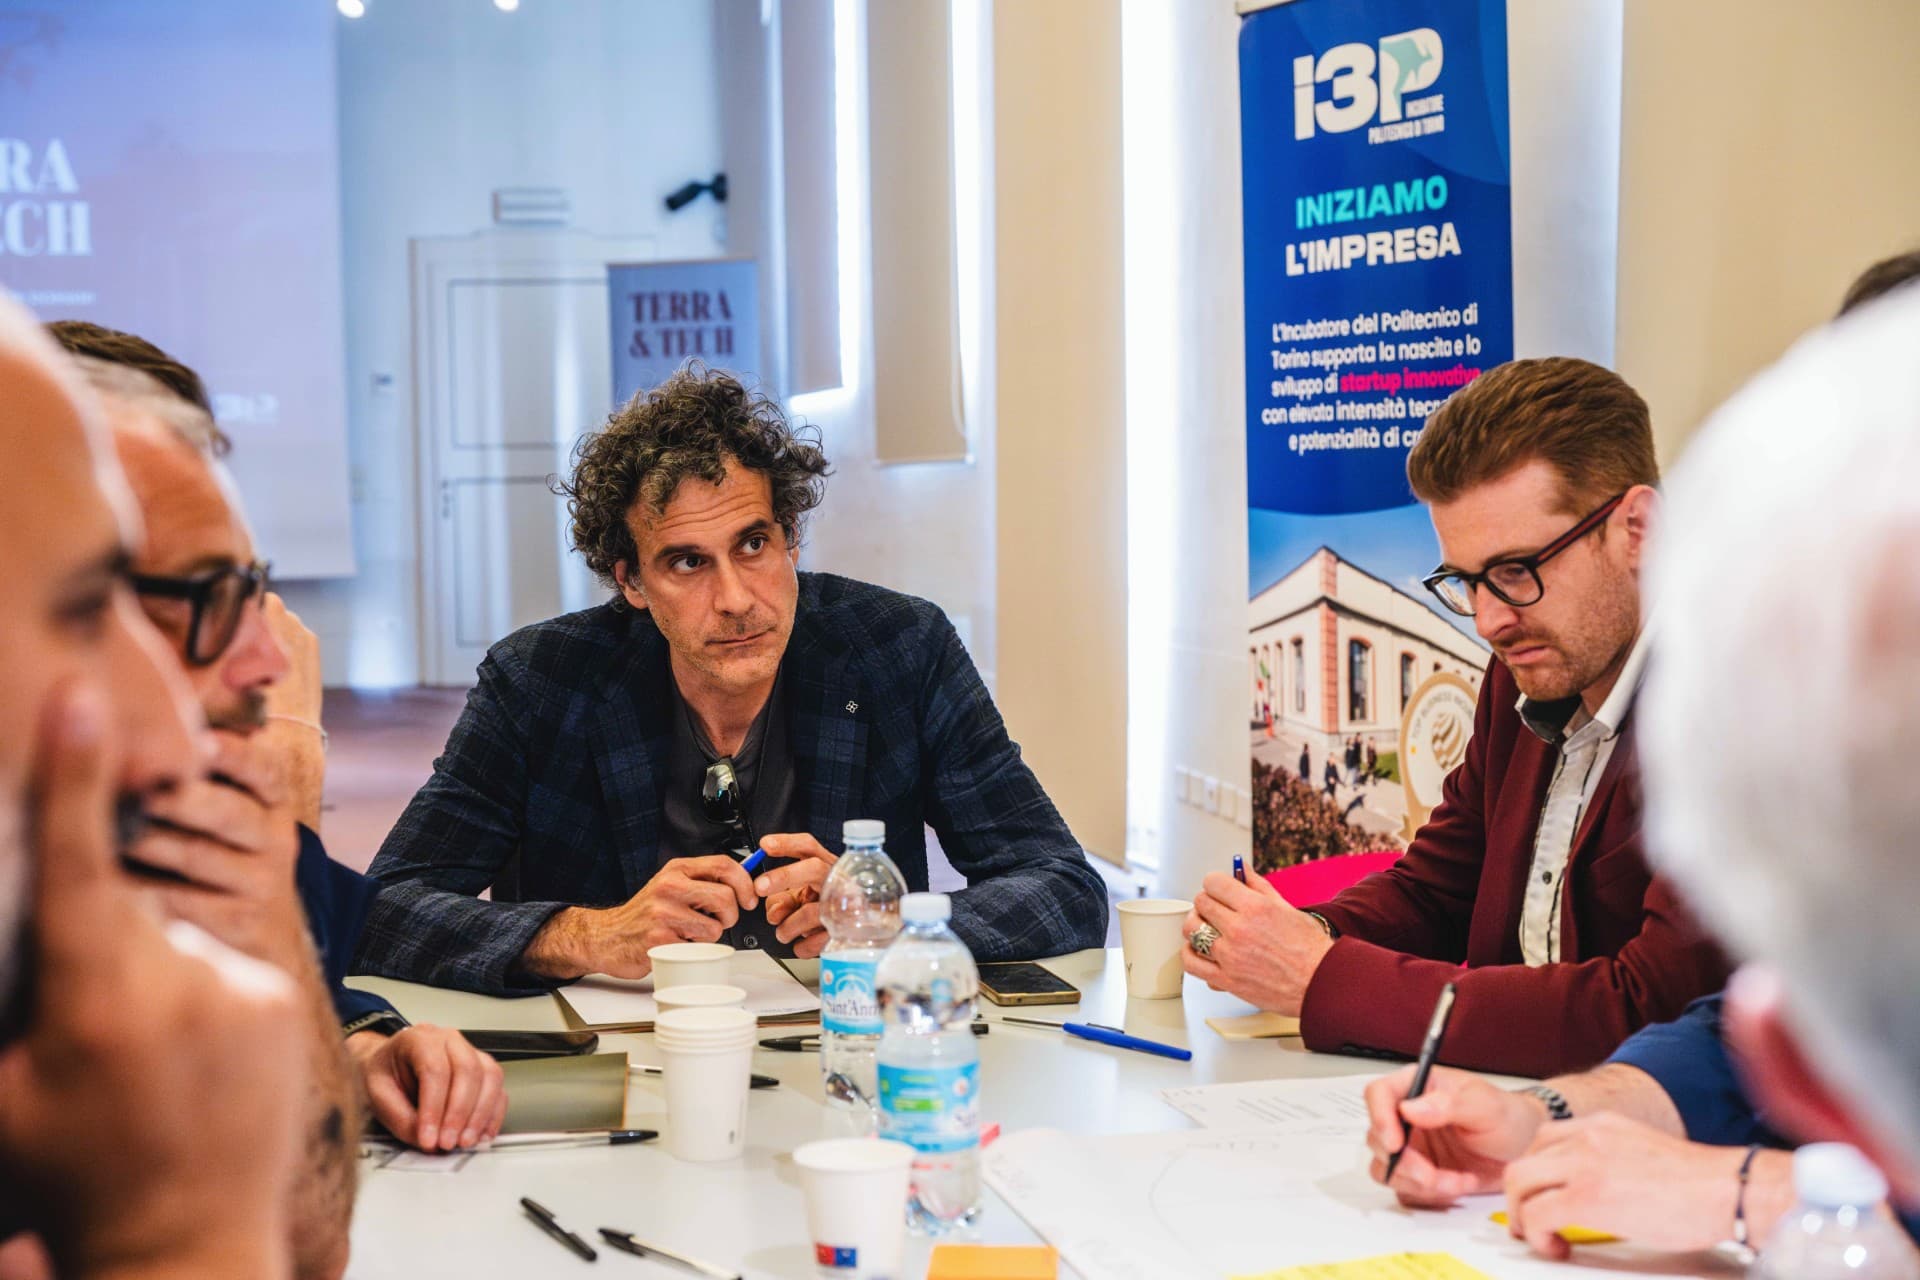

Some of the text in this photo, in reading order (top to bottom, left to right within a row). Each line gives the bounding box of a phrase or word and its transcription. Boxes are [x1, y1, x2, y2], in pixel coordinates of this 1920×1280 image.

[1296, 175, 1448, 230] INIZIAMO
[0, 200, 94, 257] CH
[1285, 222, 1462, 277] L'IMPRESA
[628, 289, 732, 324] TERRA
[1272, 302, 1479, 343] L'incubatore del Politecnico di
[628, 330, 651, 358] &
[1271, 333, 1482, 371] Torino supporta la nascita e lo
[1271, 375, 1324, 400] sviluppo
[1324, 372, 1338, 394] di
[1340, 371, 1401, 396] startup
[1261, 407, 1288, 425] con
[1289, 404, 1334, 424] elevata
[1336, 397, 1407, 421] intensità
[1288, 433, 1298, 451] e
[1298, 427, 1380, 456] potenzialità
[1382, 426, 1400, 448] di
[824, 998, 881, 1017] Sant'Ann
